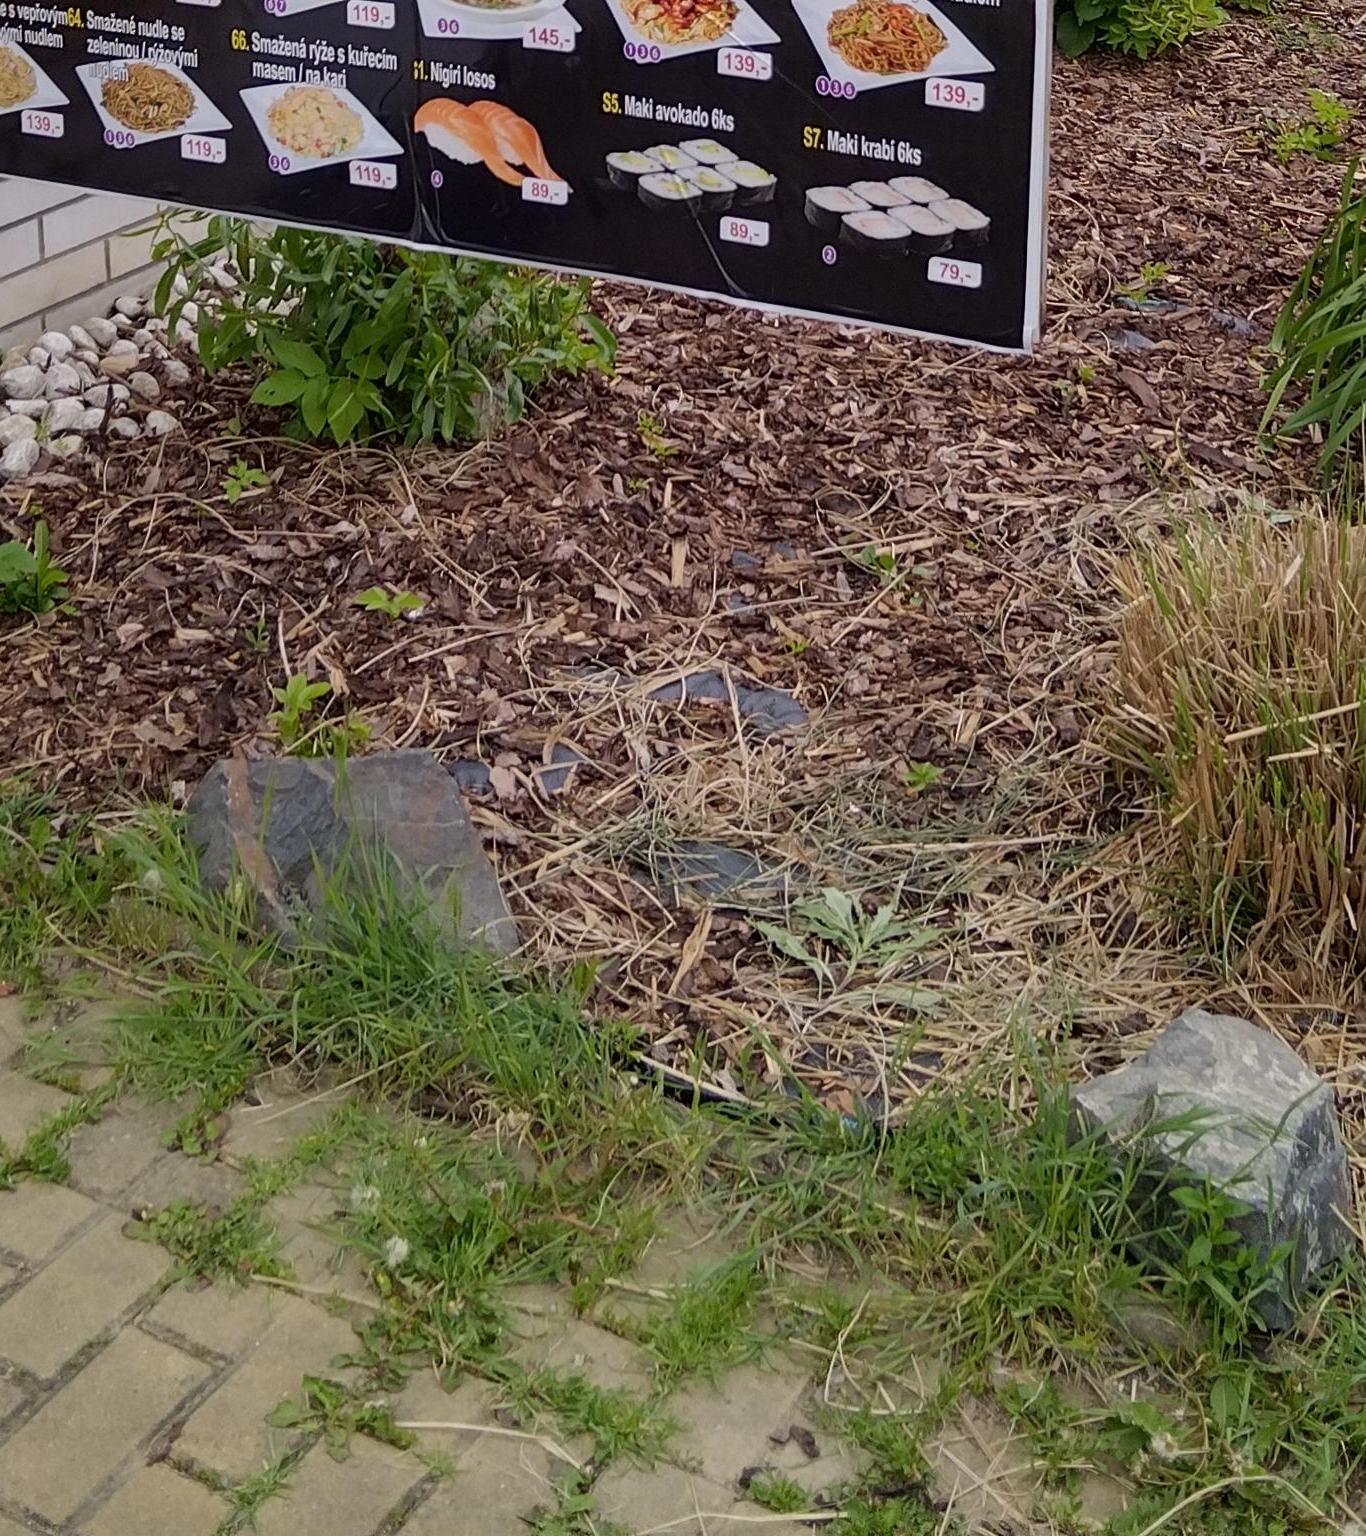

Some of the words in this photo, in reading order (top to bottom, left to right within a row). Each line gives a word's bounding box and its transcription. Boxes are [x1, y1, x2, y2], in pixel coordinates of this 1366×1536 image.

[603, 92, 621, 116] S5.
[625, 95, 652, 120] Maki
[656, 98, 709, 128] avokado
[712, 107, 734, 131] 6ks
[804, 127, 823, 151] S7.
[827, 130, 858, 154] Maki
[897, 141, 921, 166] 6ks
